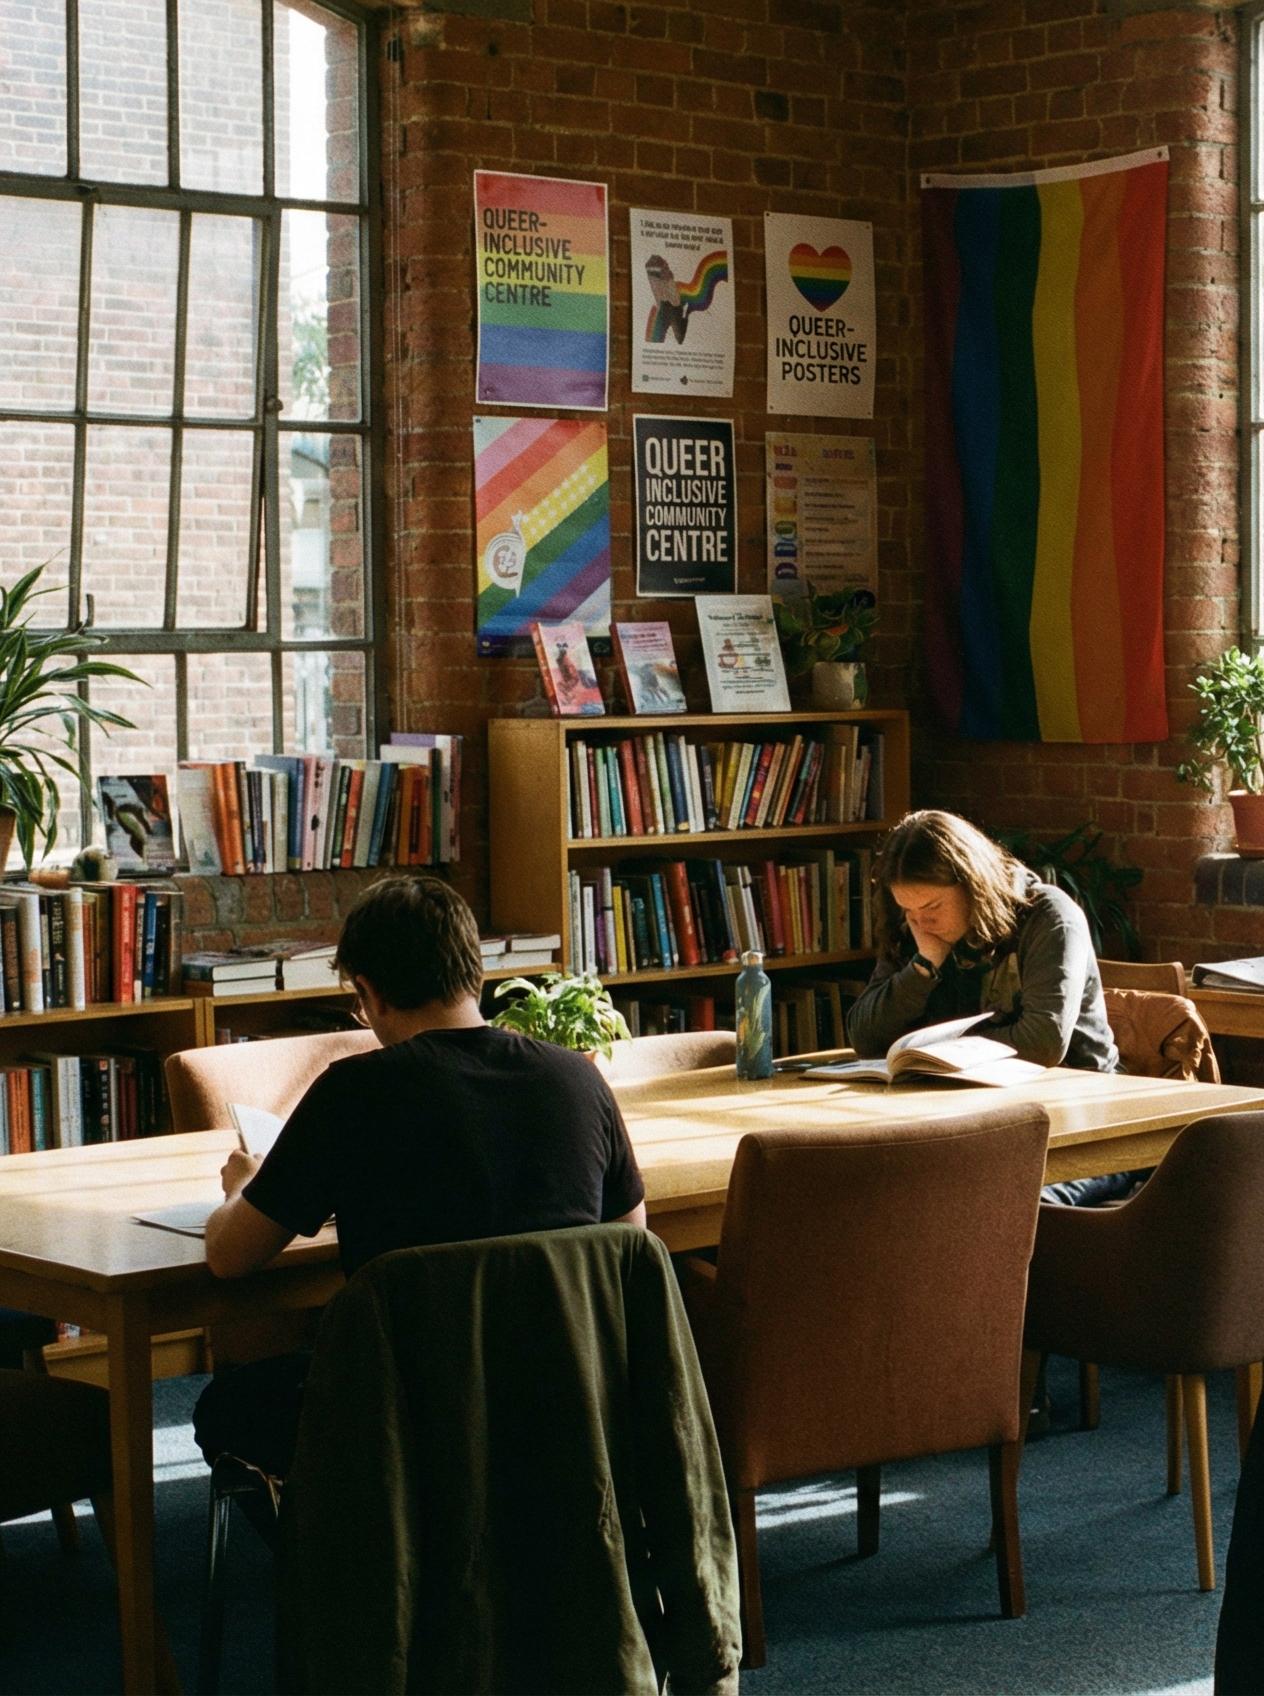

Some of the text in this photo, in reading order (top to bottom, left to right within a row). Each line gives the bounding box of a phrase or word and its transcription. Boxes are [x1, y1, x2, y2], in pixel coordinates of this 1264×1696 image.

[483, 208, 547, 233] QUEER-
[484, 233, 572, 261] INCLUSIVE
[484, 258, 585, 285] COMMUNITY
[485, 284, 552, 307] CENTRE
[789, 315, 854, 338] QUEER-
[776, 338, 867, 363] INCLUSIVE
[782, 362, 861, 386] POSTERS
[645, 437, 725, 478] QUEER
[645, 479, 727, 505] INCLUSIVE
[645, 506, 727, 527] COMMUNITY
[645, 530, 728, 562] CENTRE
